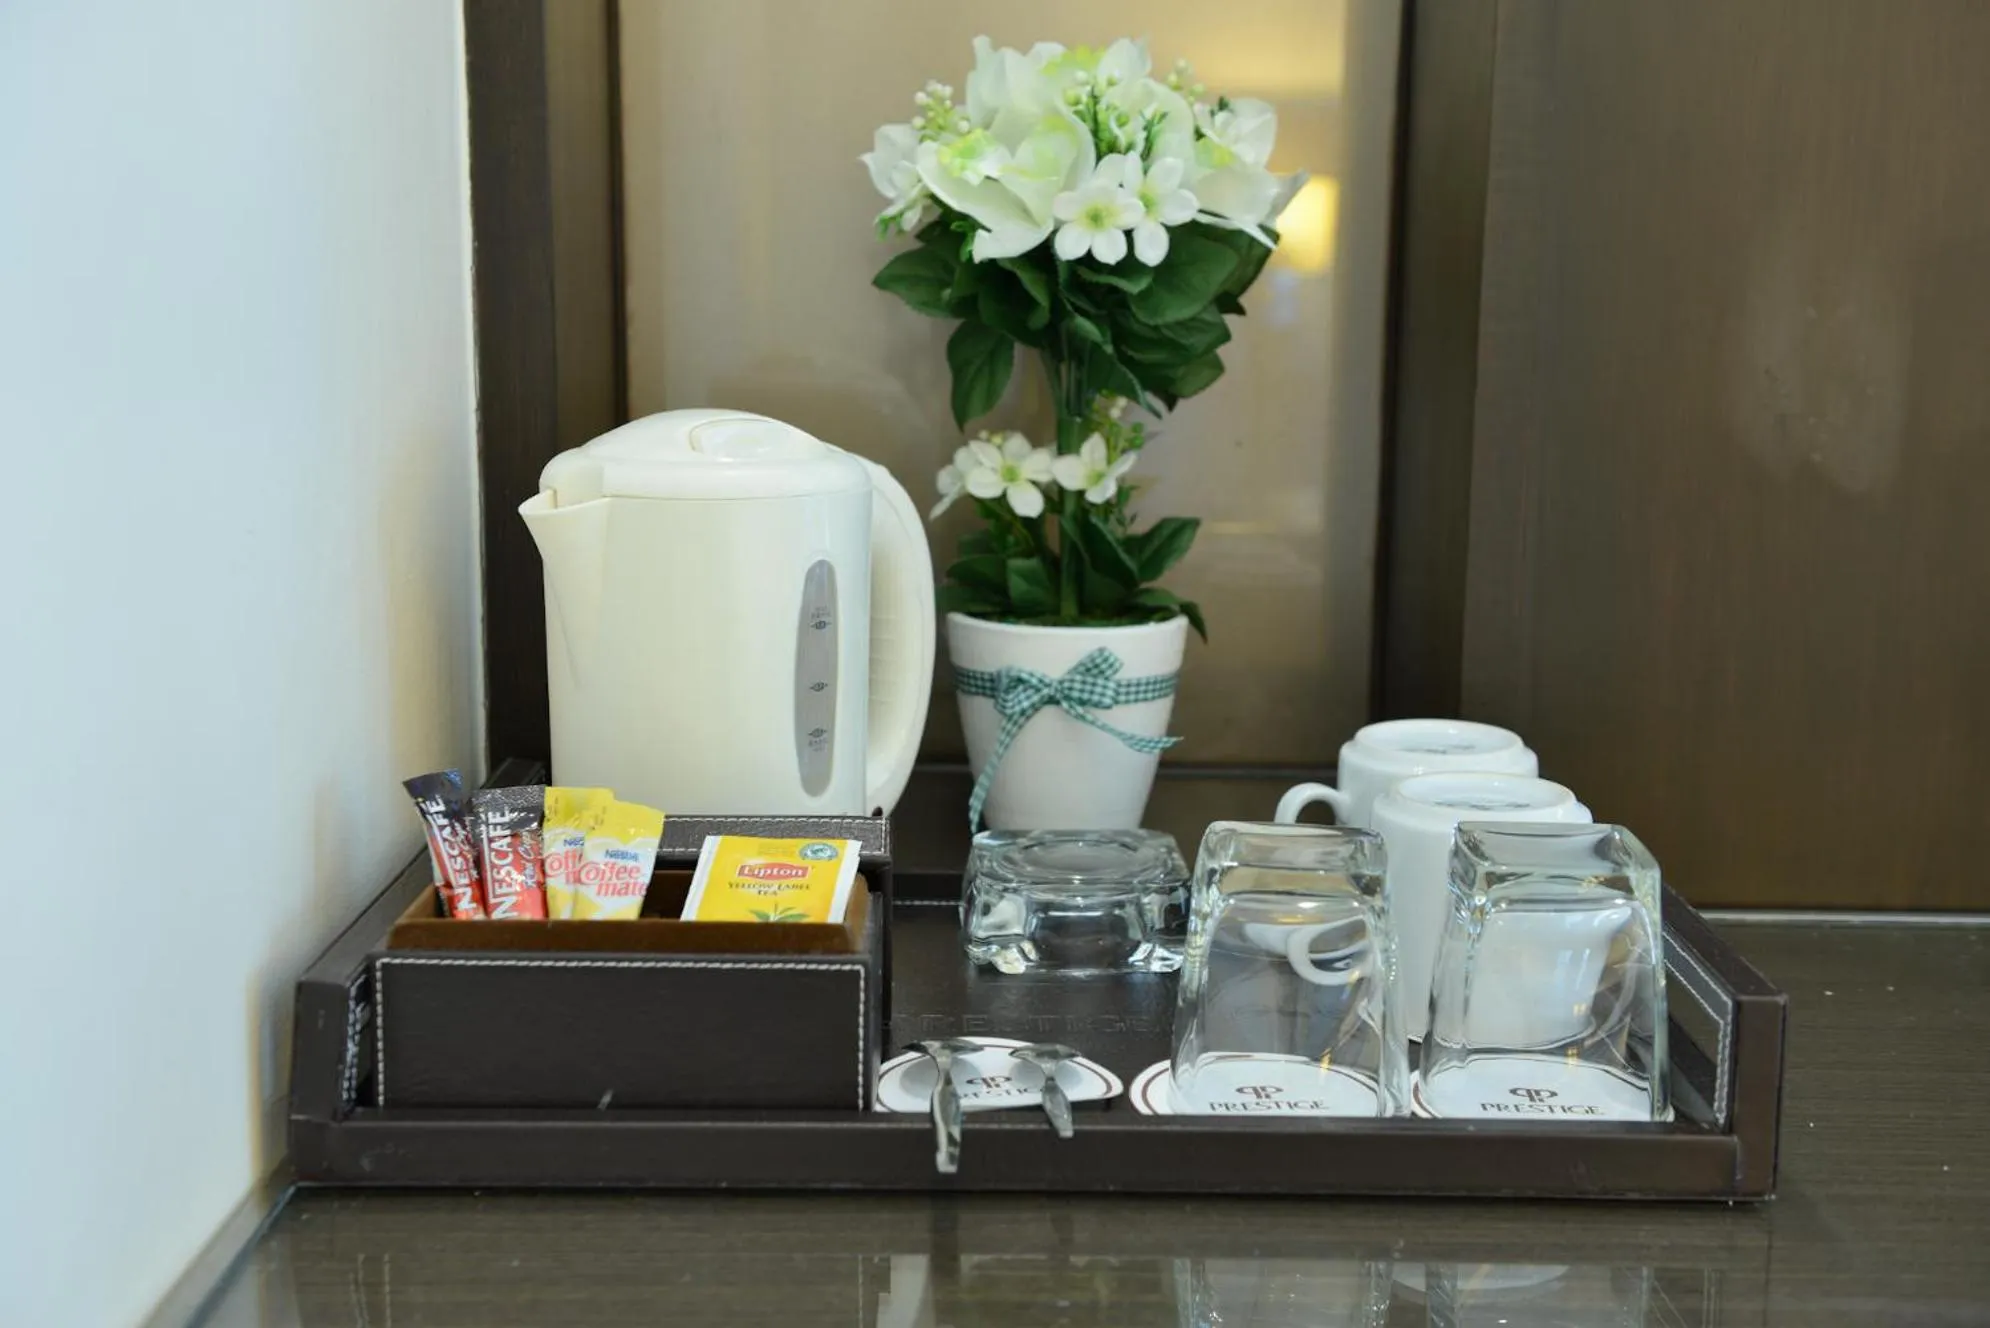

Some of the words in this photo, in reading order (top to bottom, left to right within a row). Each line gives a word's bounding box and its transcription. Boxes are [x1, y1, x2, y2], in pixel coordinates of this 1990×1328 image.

[743, 865, 804, 878] Lipton
[1209, 1100, 1329, 1112] PRESTIGE
[1480, 1103, 1606, 1115] PRESTIGE
